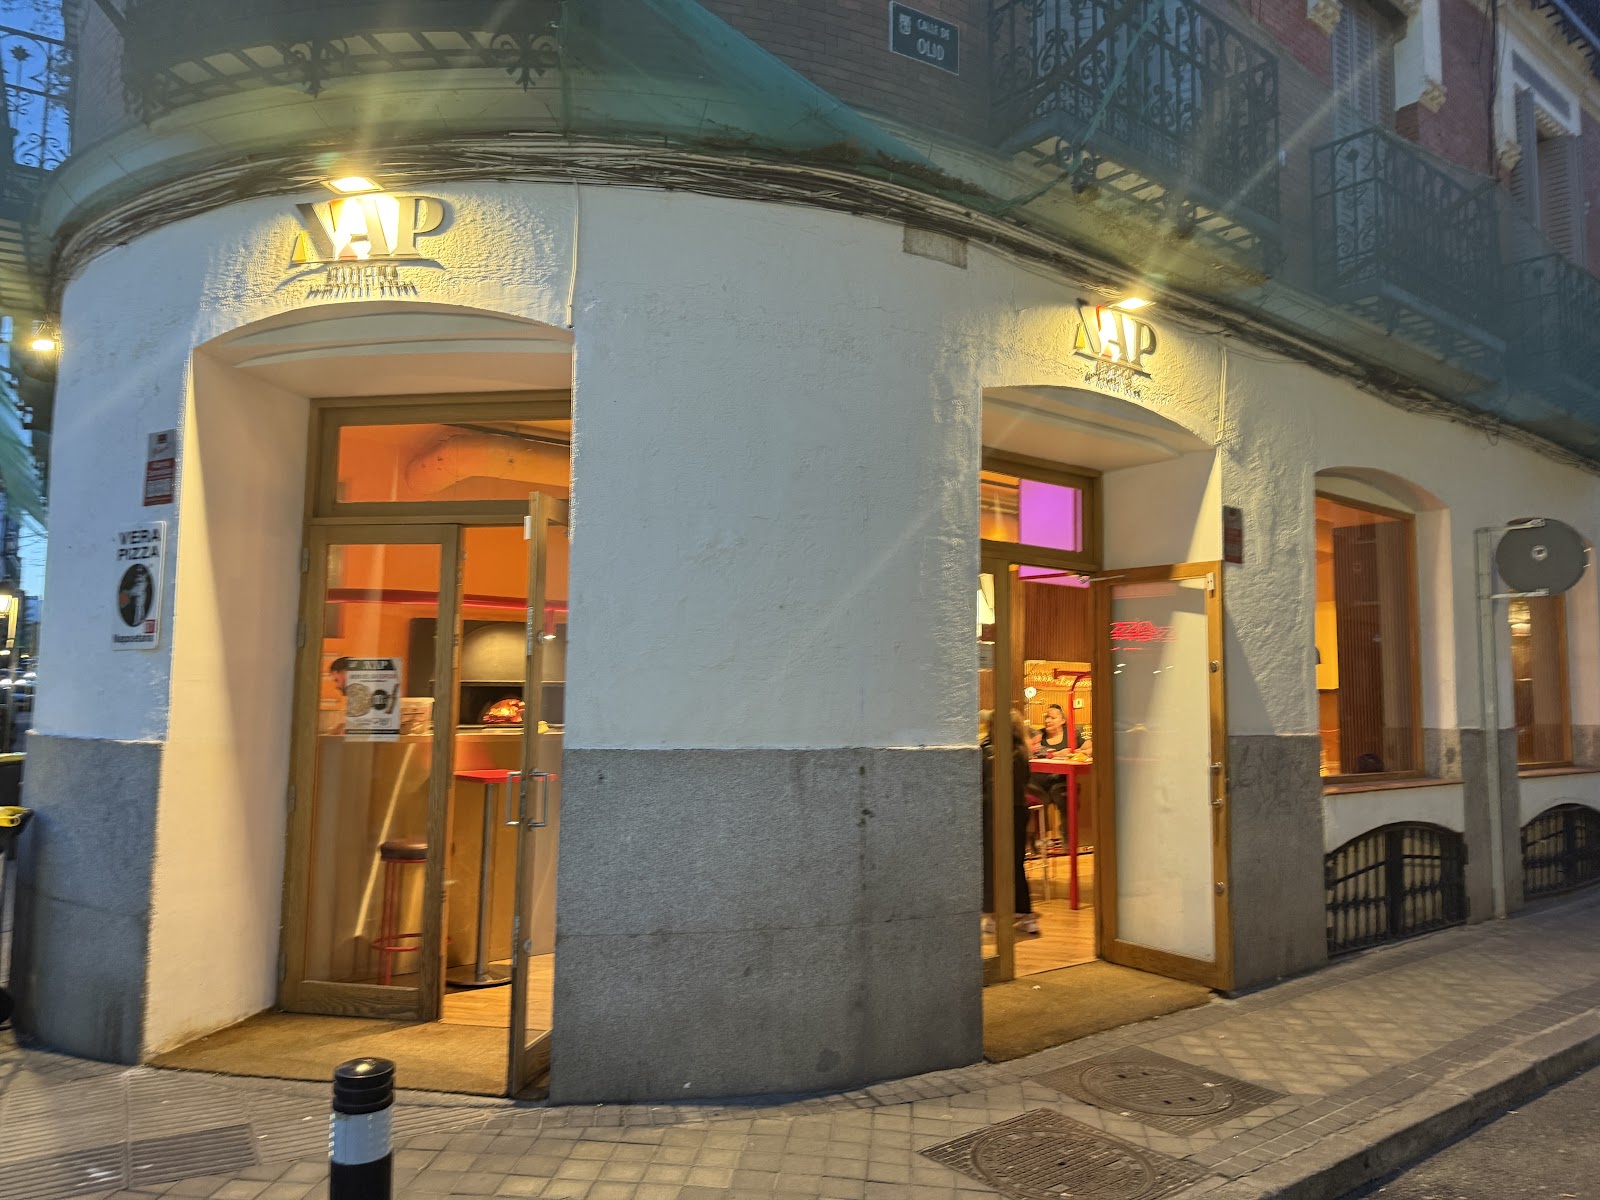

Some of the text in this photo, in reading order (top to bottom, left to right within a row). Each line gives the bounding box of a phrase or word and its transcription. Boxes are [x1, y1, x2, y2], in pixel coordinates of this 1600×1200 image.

[916, 38, 944, 60] OLID
[118, 528, 160, 545] VERA
[117, 545, 159, 560] PIZZA
